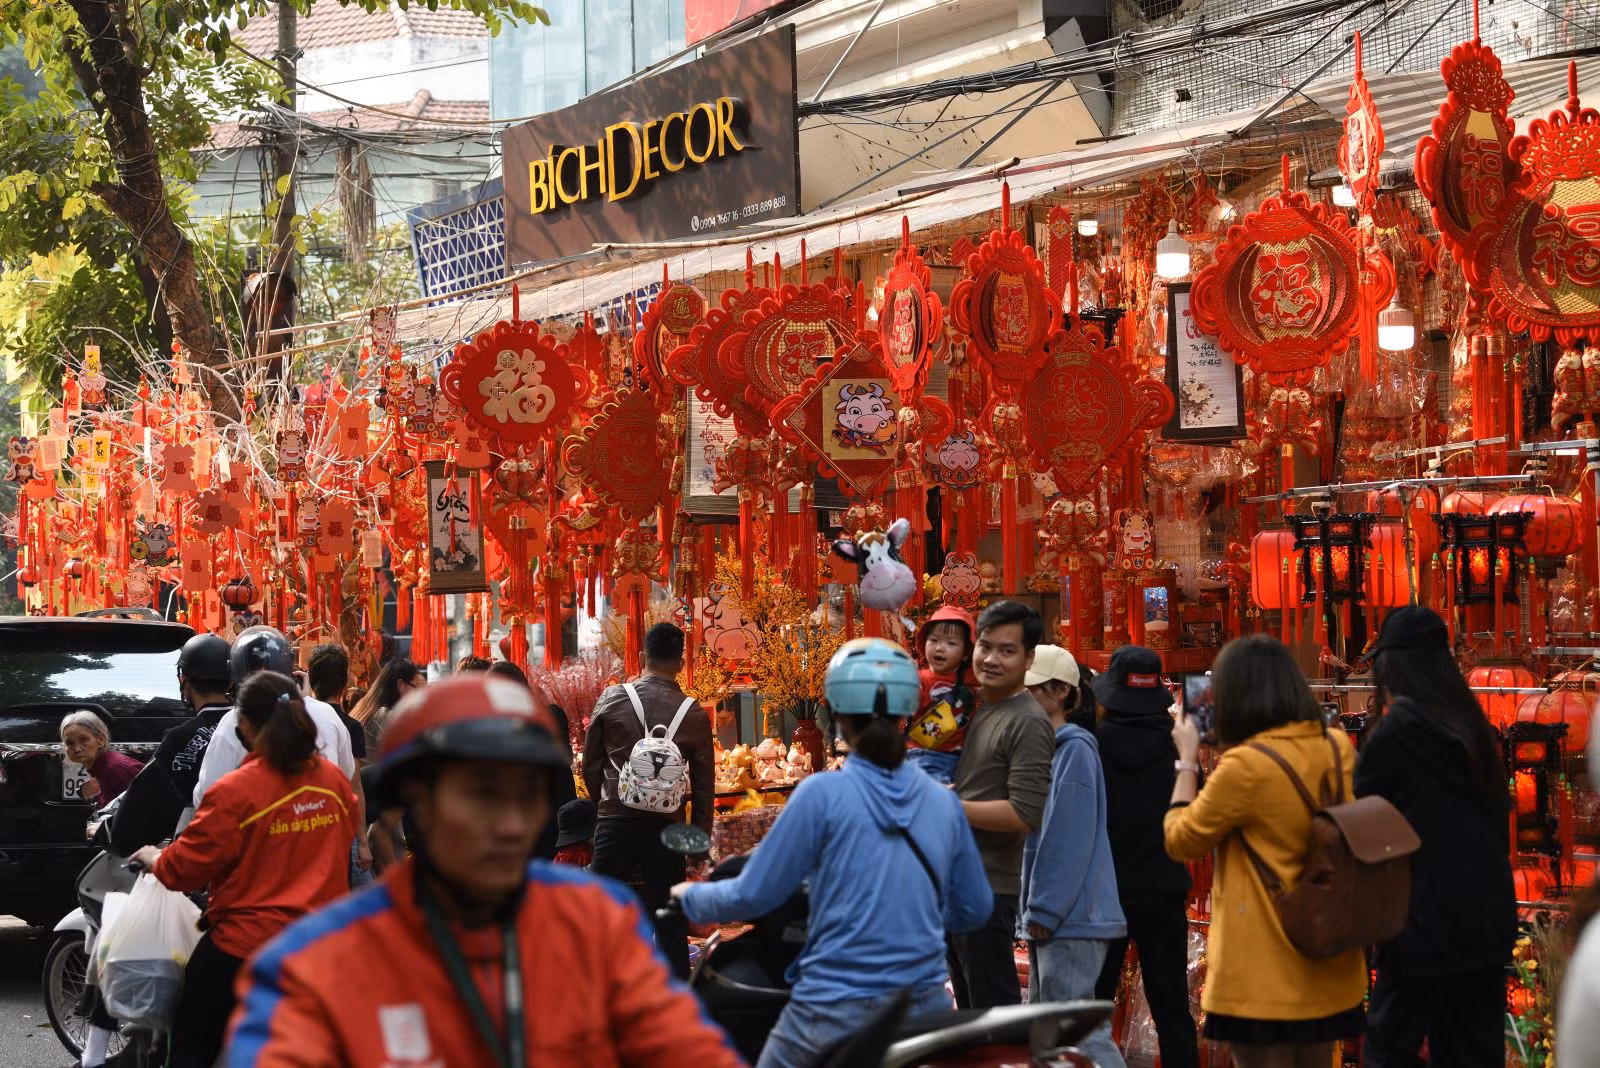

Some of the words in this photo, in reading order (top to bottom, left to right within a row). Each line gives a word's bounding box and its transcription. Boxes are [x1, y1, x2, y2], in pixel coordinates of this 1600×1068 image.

[699, 216, 716, 230] 0904
[743, 204, 759, 218] 0333
[773, 195, 786, 209] 888
